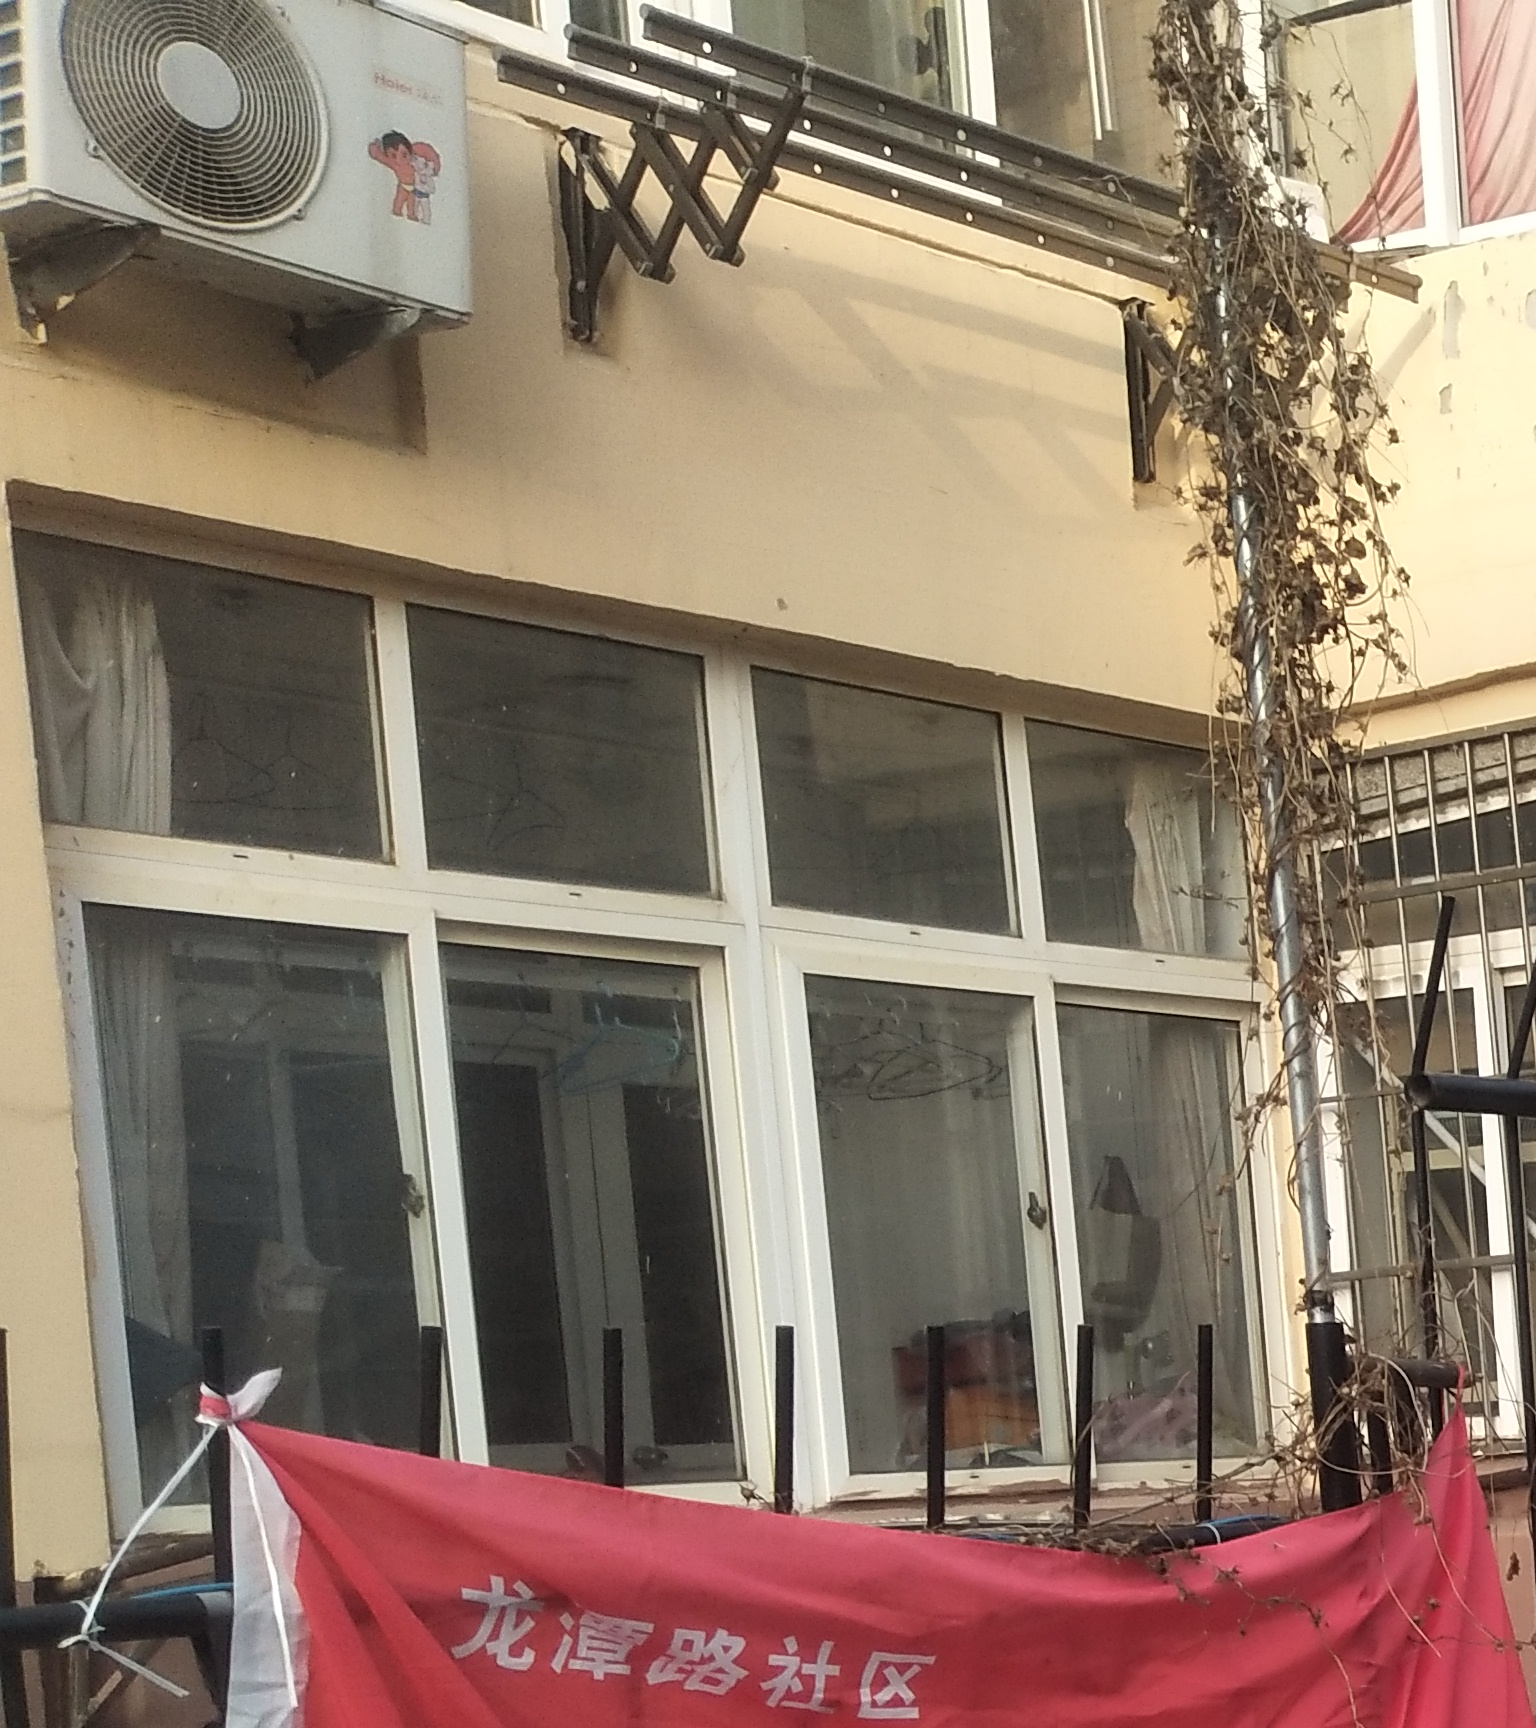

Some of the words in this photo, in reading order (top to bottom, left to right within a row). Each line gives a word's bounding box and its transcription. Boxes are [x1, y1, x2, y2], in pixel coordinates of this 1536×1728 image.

[450, 1574, 937, 1721] 龙潭路社区
